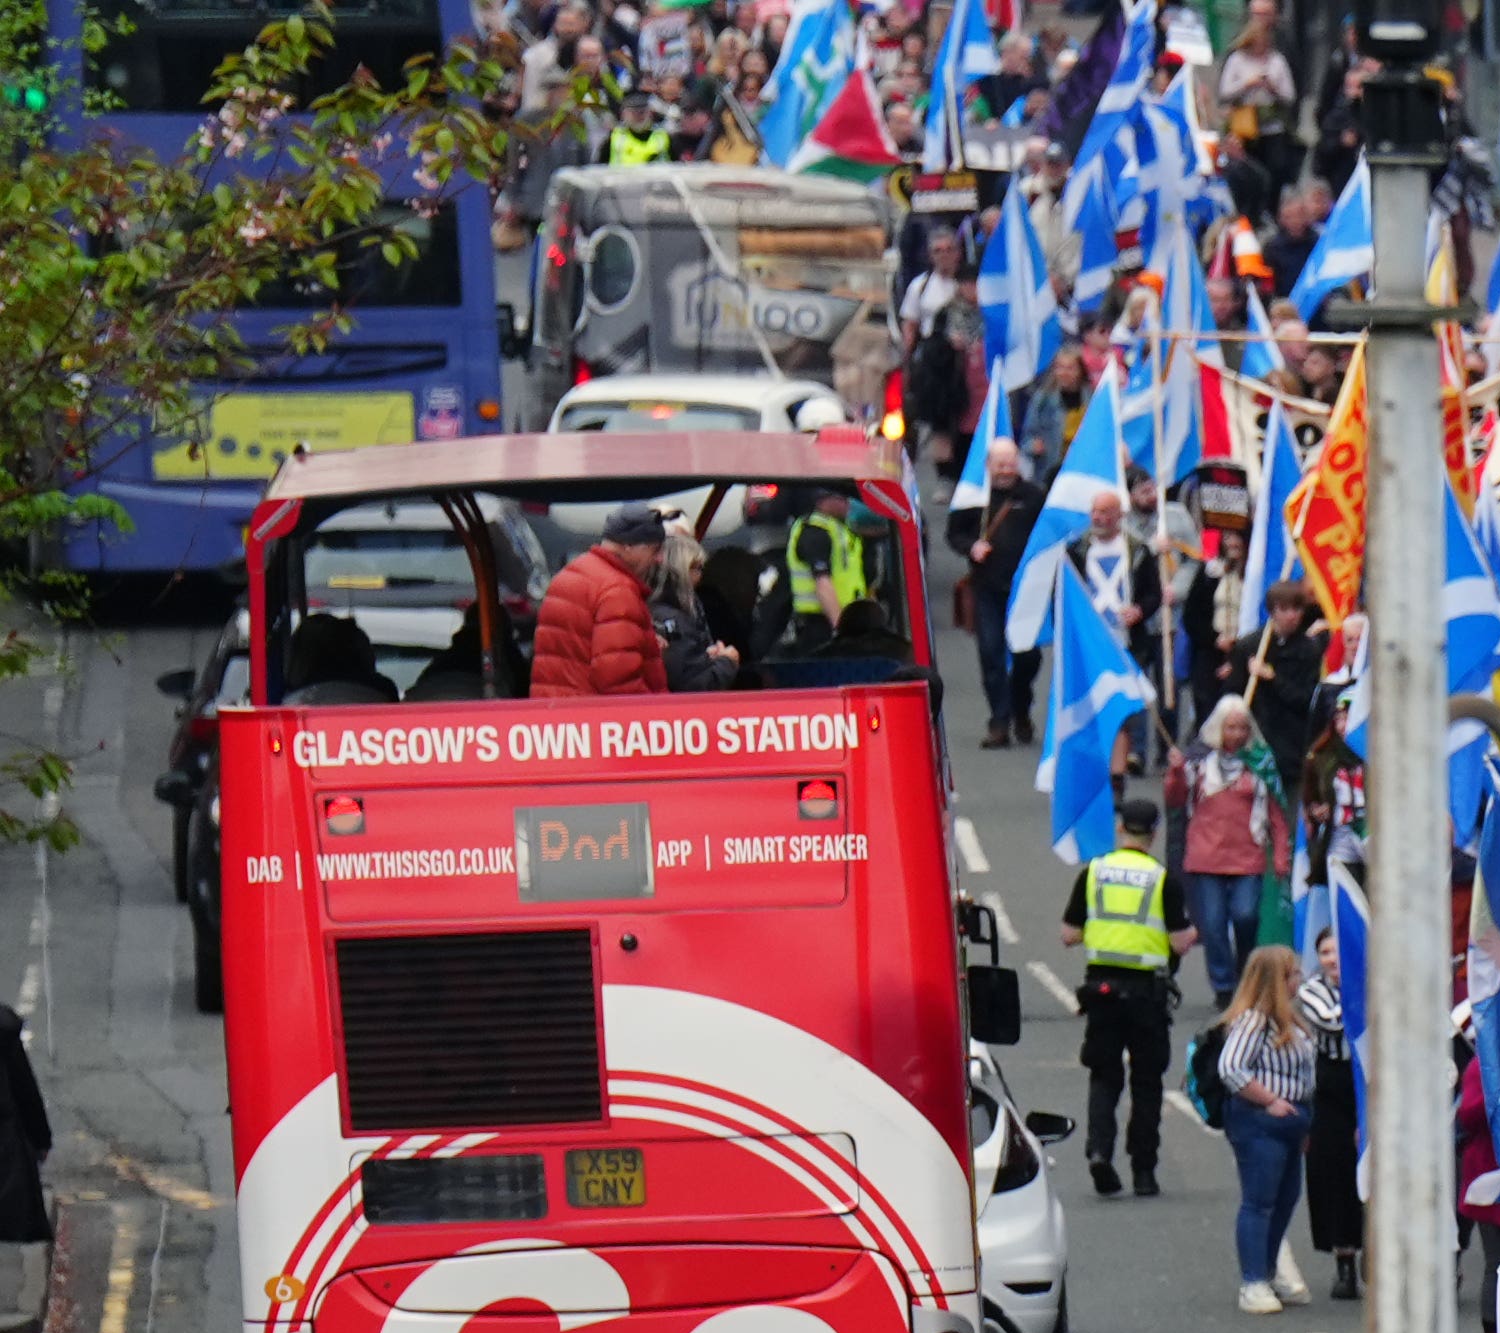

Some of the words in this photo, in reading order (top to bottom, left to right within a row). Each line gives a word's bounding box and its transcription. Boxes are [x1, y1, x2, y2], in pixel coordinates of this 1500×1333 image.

[293, 724, 500, 769] GLASGOW'S
[507, 722, 592, 762] OWN
[600, 718, 709, 760] RADIO
[717, 712, 860, 756] STATION
[246, 855, 283, 883] DAB
[316, 845, 514, 883] WWW.THISISGO.CO.UK
[656, 840, 692, 868] APP
[723, 835, 787, 865] SMART
[789, 833, 868, 864] SPEAKER
[582, 1175, 635, 1201] CNY
[274, 1277, 293, 1299] 6
